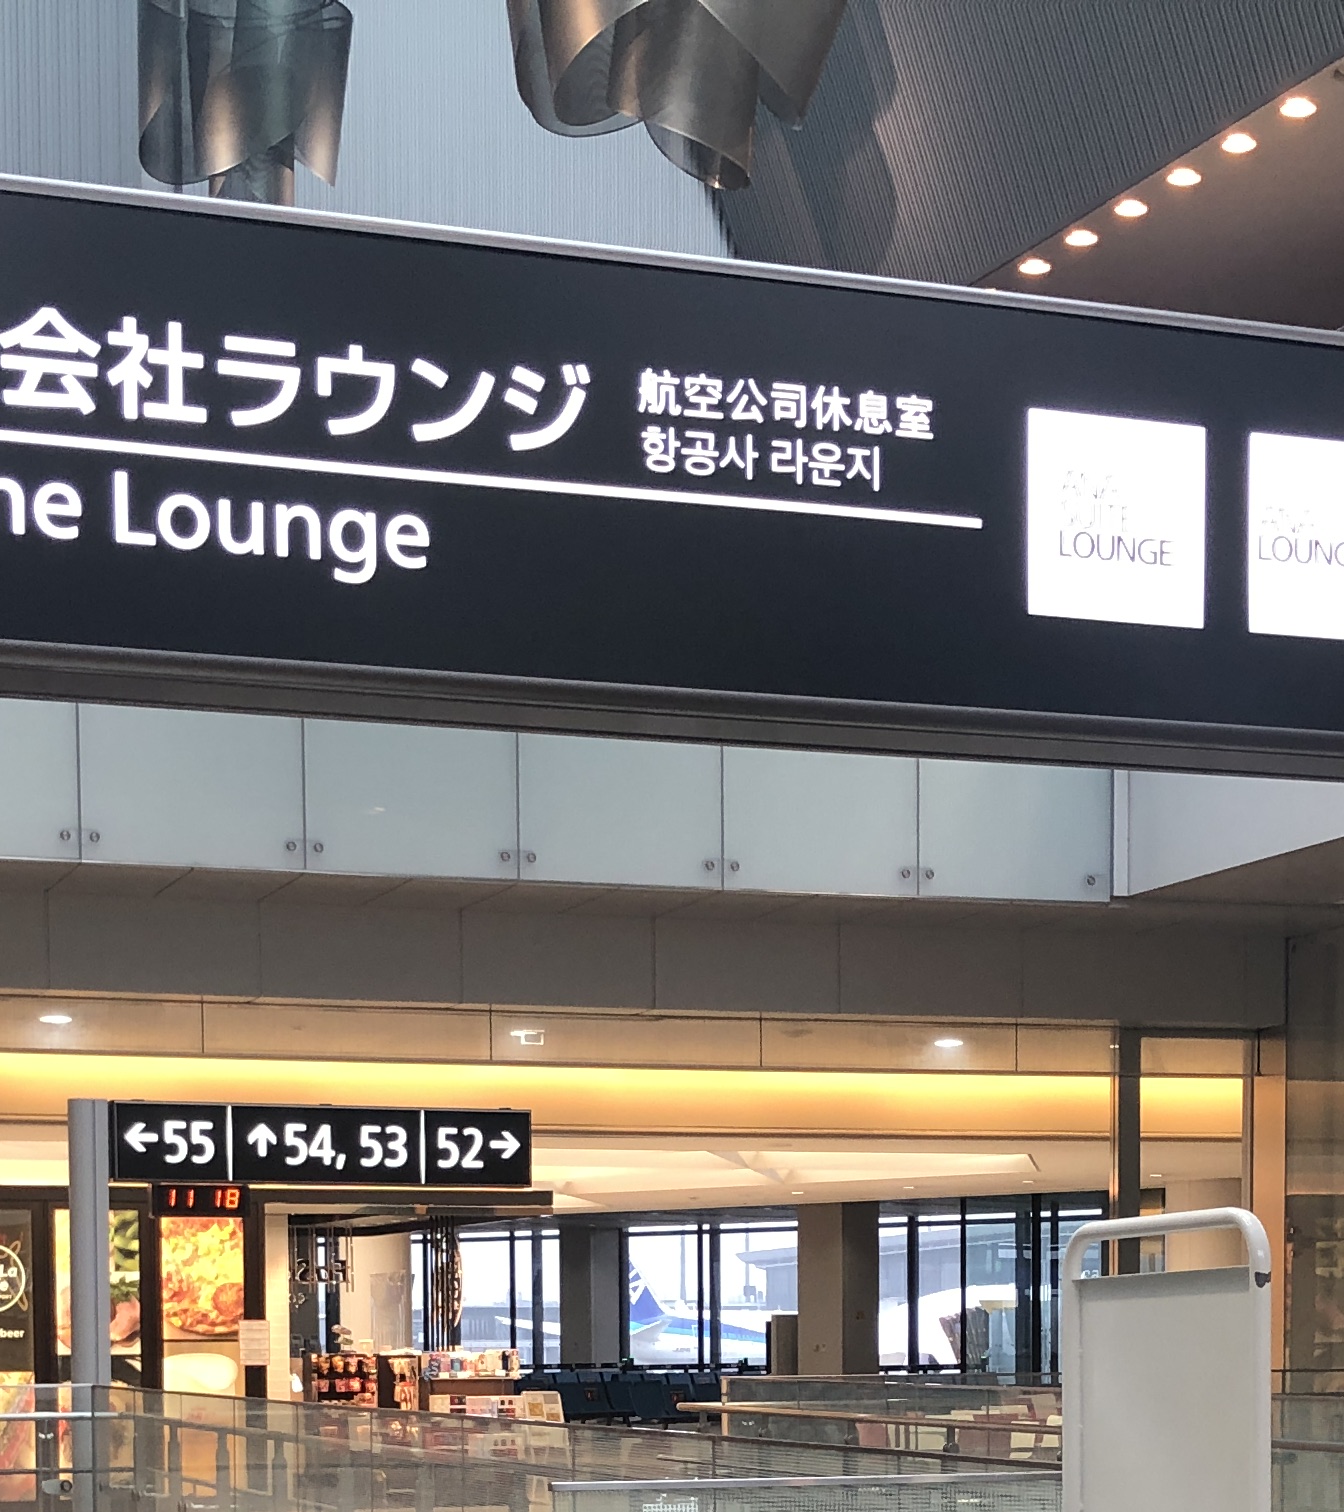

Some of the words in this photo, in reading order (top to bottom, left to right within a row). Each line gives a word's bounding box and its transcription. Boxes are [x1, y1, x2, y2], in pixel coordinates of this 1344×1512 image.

[637, 366, 936, 444] 航空公司休息室
[640, 427, 759, 484] 항공사
[769, 434, 883, 494] 라운지
[114, 471, 432, 585] Lounge
[1059, 530, 1174, 566] LOUNGE
[163, 1120, 215, 1165] 55
[284, 1123, 347, 1171] 54,
[360, 1125, 408, 1167] 53
[436, 1127, 485, 1169] 52
